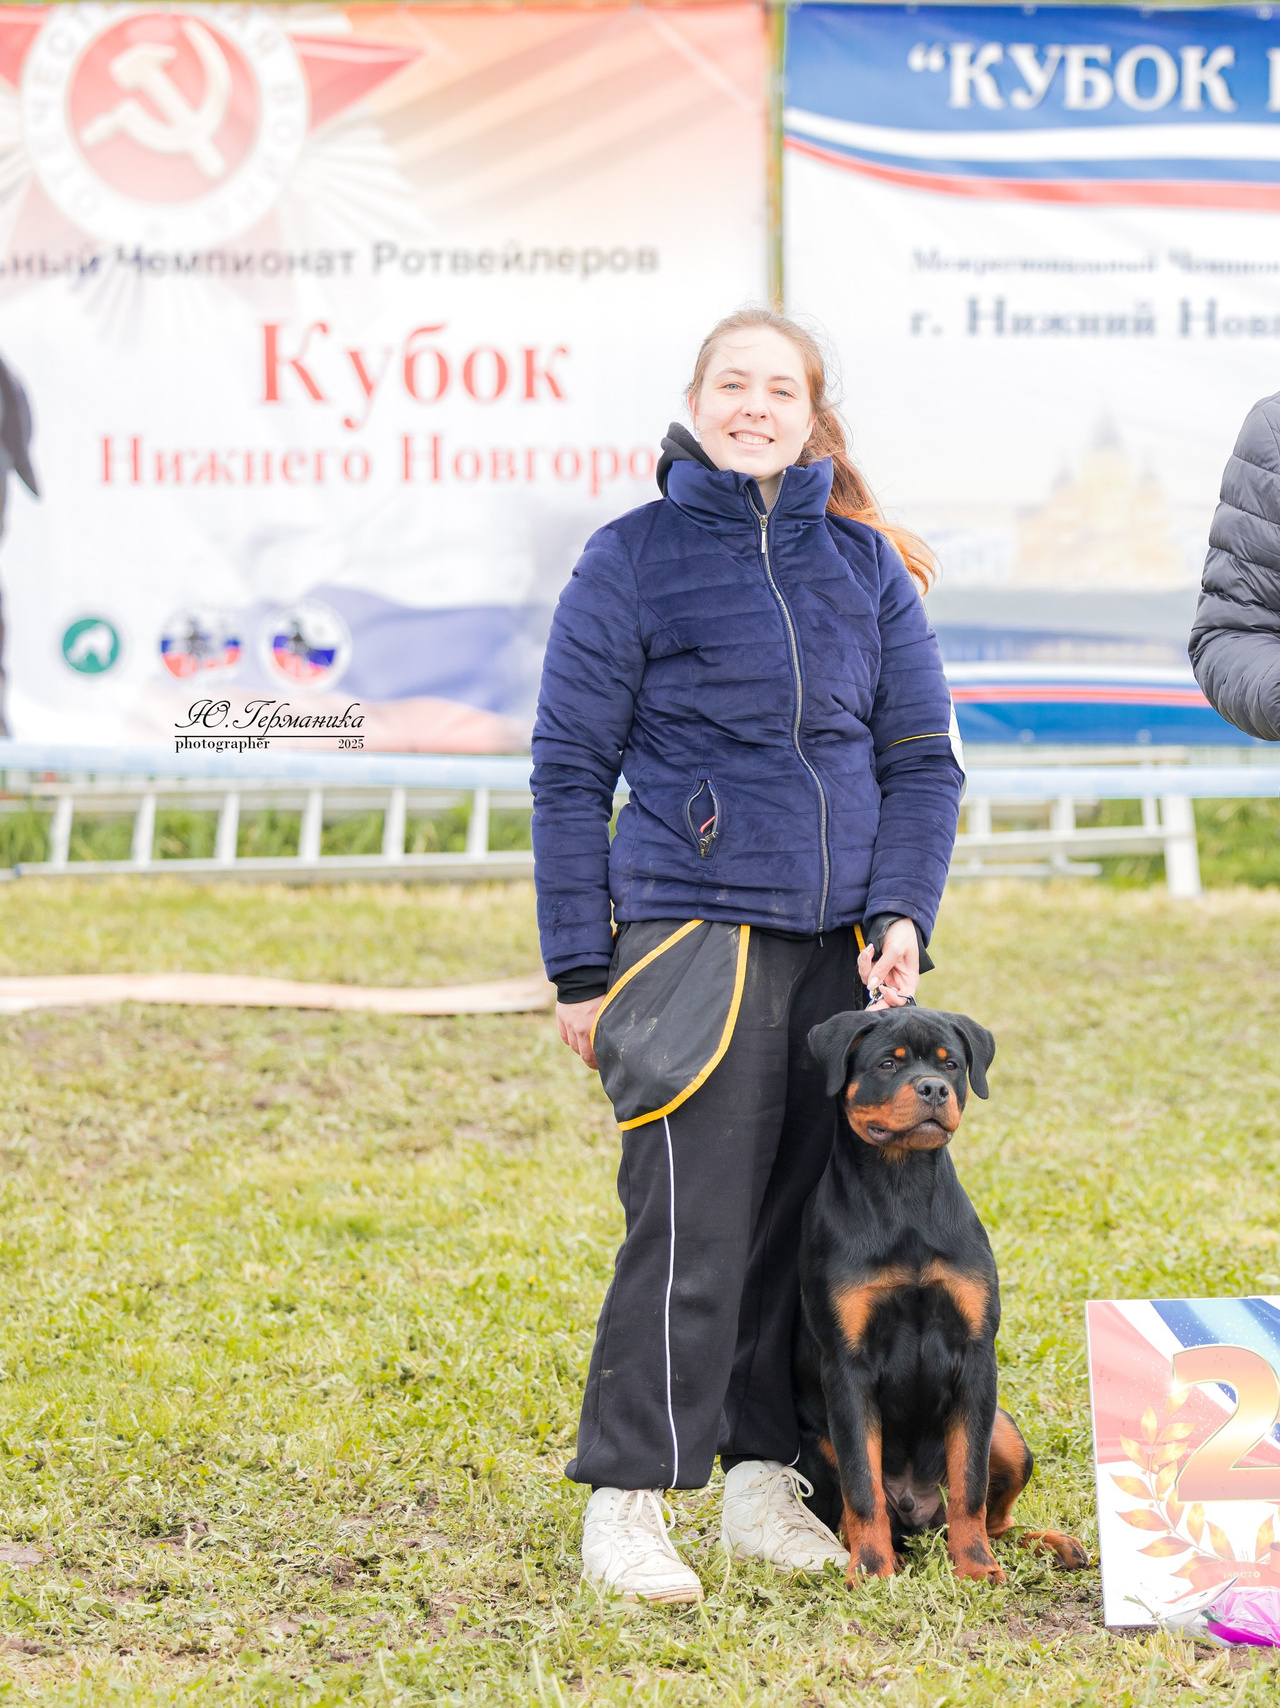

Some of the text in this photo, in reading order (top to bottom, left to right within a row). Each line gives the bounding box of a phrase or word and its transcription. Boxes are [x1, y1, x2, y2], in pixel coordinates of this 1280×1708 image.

[907, 42, 1238, 112] “КУБОК
[116, 243, 357, 278] Чемпионат
[372, 240, 661, 282] Ротвейлеров
[965, 297, 1159, 338] Нижний
[260, 320, 571, 430] Кубок
[101, 433, 657, 497] Нижнего Новгоро
